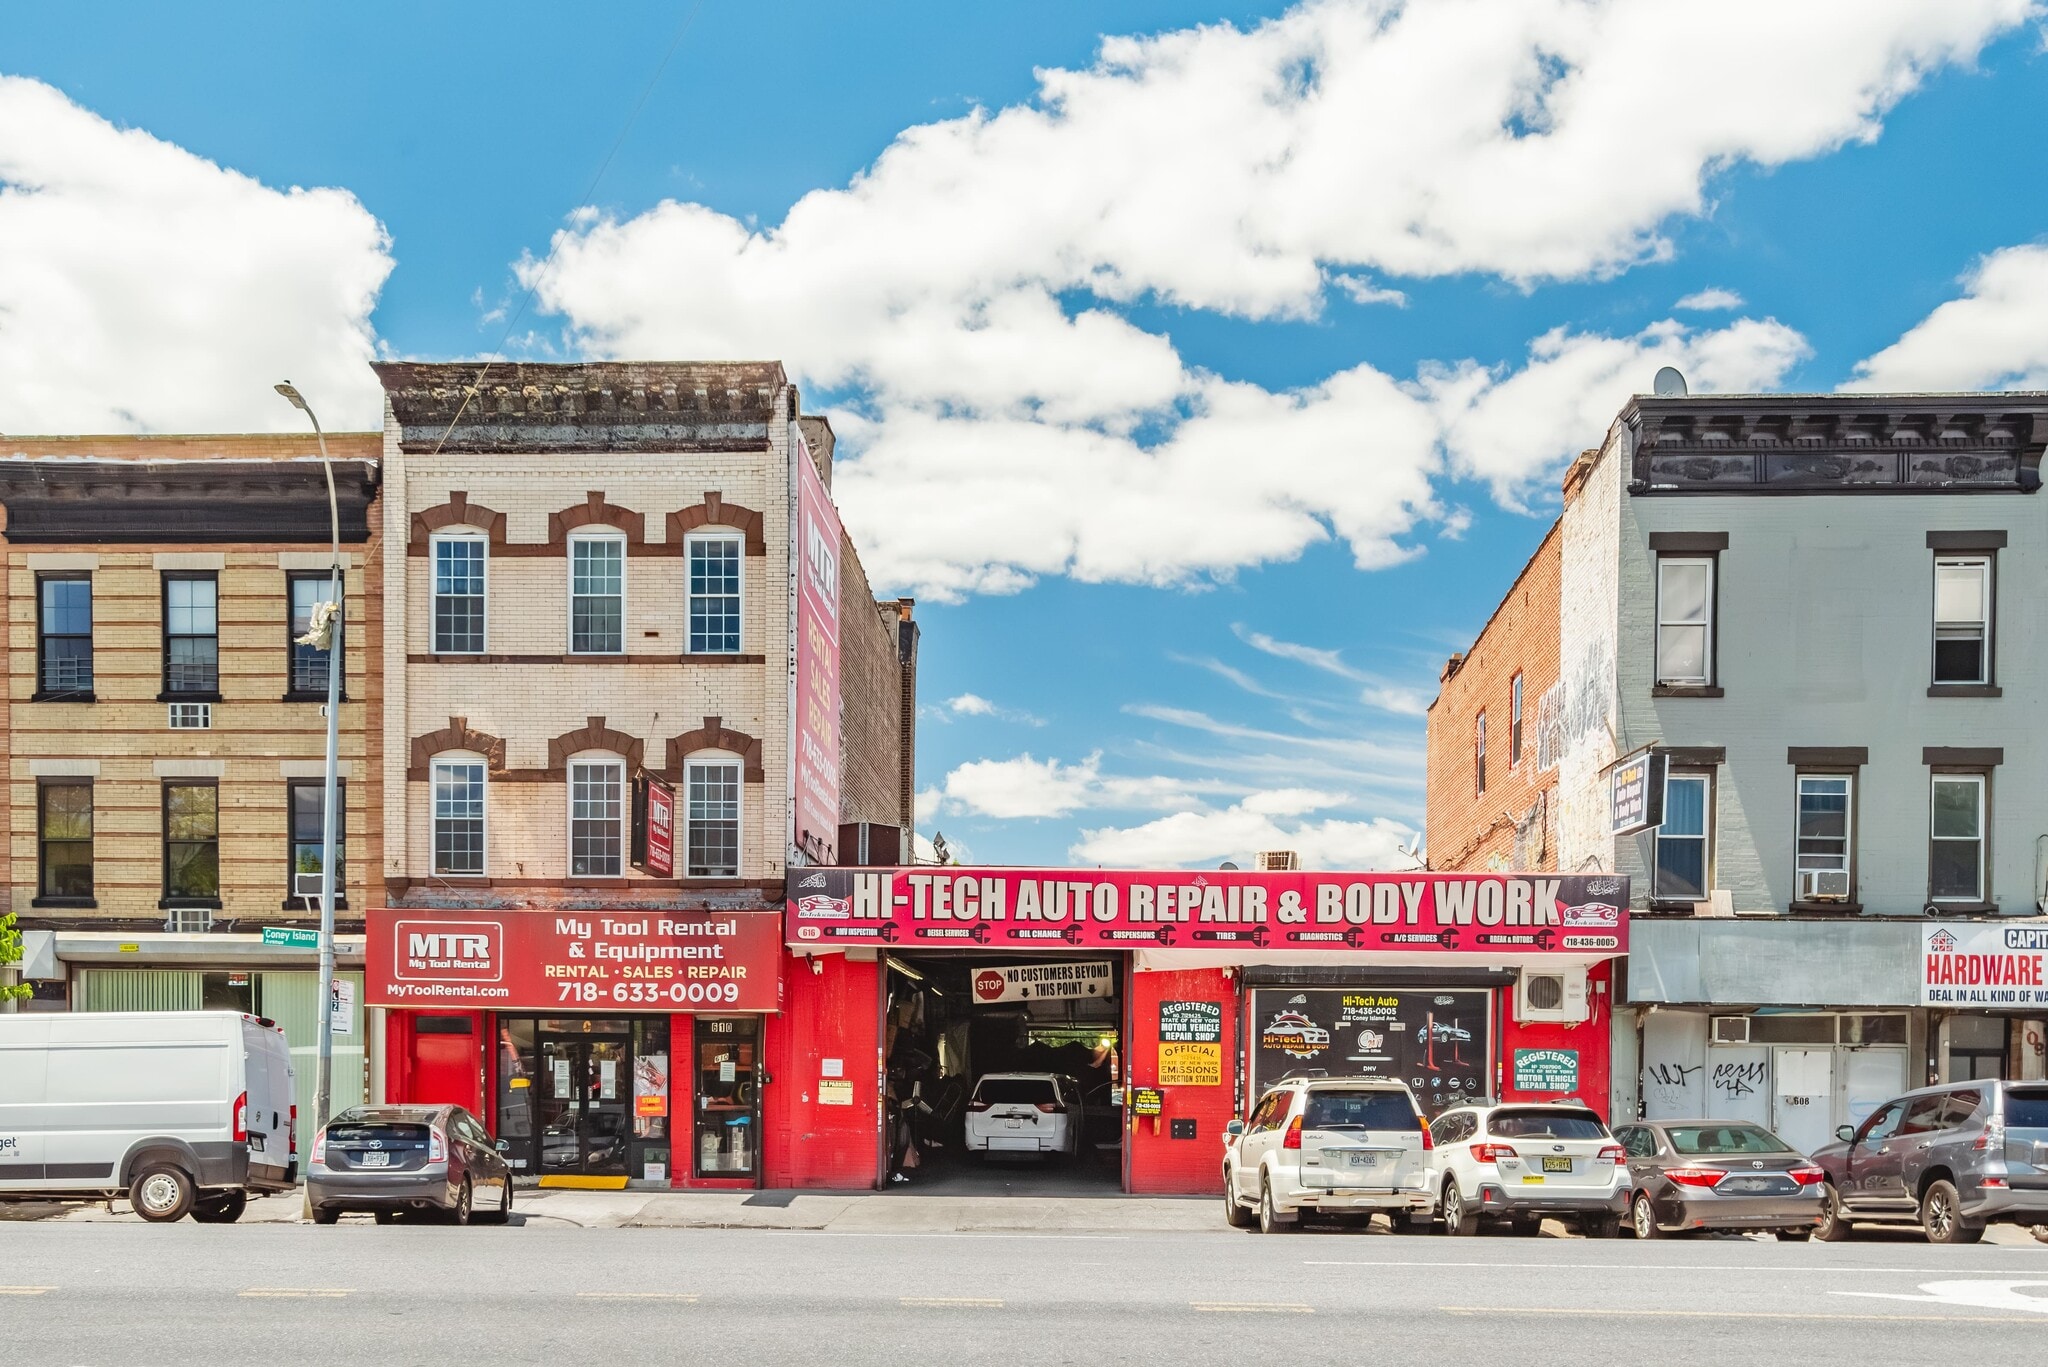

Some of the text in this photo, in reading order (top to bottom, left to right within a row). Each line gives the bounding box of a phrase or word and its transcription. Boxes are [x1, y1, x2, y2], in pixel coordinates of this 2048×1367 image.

[808, 510, 835, 602] MTR
[808, 614, 833, 679] RENTAL
[810, 659, 830, 712] SALES
[809, 696, 832, 751] REPAIR
[854, 874, 1561, 926] HI-TECH AUTO REPAIR & BODY WORK
[556, 918, 737, 939] My Tool Rental
[1032, 930, 1061, 938] CHANGE
[265, 930, 316, 941] Coney Island
[1113, 931, 1155, 939] SUSPENSIONS
[1216, 932, 1236, 940] TIRES
[1300, 933, 1343, 941] DIAGNOSTICS
[1407, 934, 1437, 942] SERVICES
[2007, 930, 2048, 948] CAPIT
[409, 934, 490, 958] MTR
[1566, 937, 1615, 946] 718-436-0005
[569, 942, 724, 962] & Equipment
[409, 960, 490, 969] My Tool Rental
[1927, 954, 2043, 986] HARDWARE
[545, 965, 747, 978] RENTAL SALES REPAIR
[1007, 964, 1108, 982] NO CUSTOMERS BEYOND
[388, 985, 509, 997] MyToolRental.com
[977, 980, 1002, 990] STOP
[1035, 982, 1082, 996] THIS POINT
[1343, 996, 1398, 1006] Hi-Tech Auto
[1930, 990, 1953, 1001] DEAL
[1956, 990, 1967, 1001] IN
[1970, 990, 1988, 1002] ALL
[1991, 990, 2016, 1002] KIND
[2019, 991, 2031, 1002] OF
[1162, 1002, 1220, 1016] REGISTERED
[712, 1023, 732, 1032] 610
[1161, 1023, 1186, 1031] MOTOR
[1166, 1032, 1215, 1040] REPAIR SHOP
[1263, 1035, 1303, 1043] Hi-Tech
[1165, 1045, 1214, 1057] OFFICIAL
[1516, 1051, 1576, 1068] REGISTERED
[1794, 1097, 1809, 1105] 608
